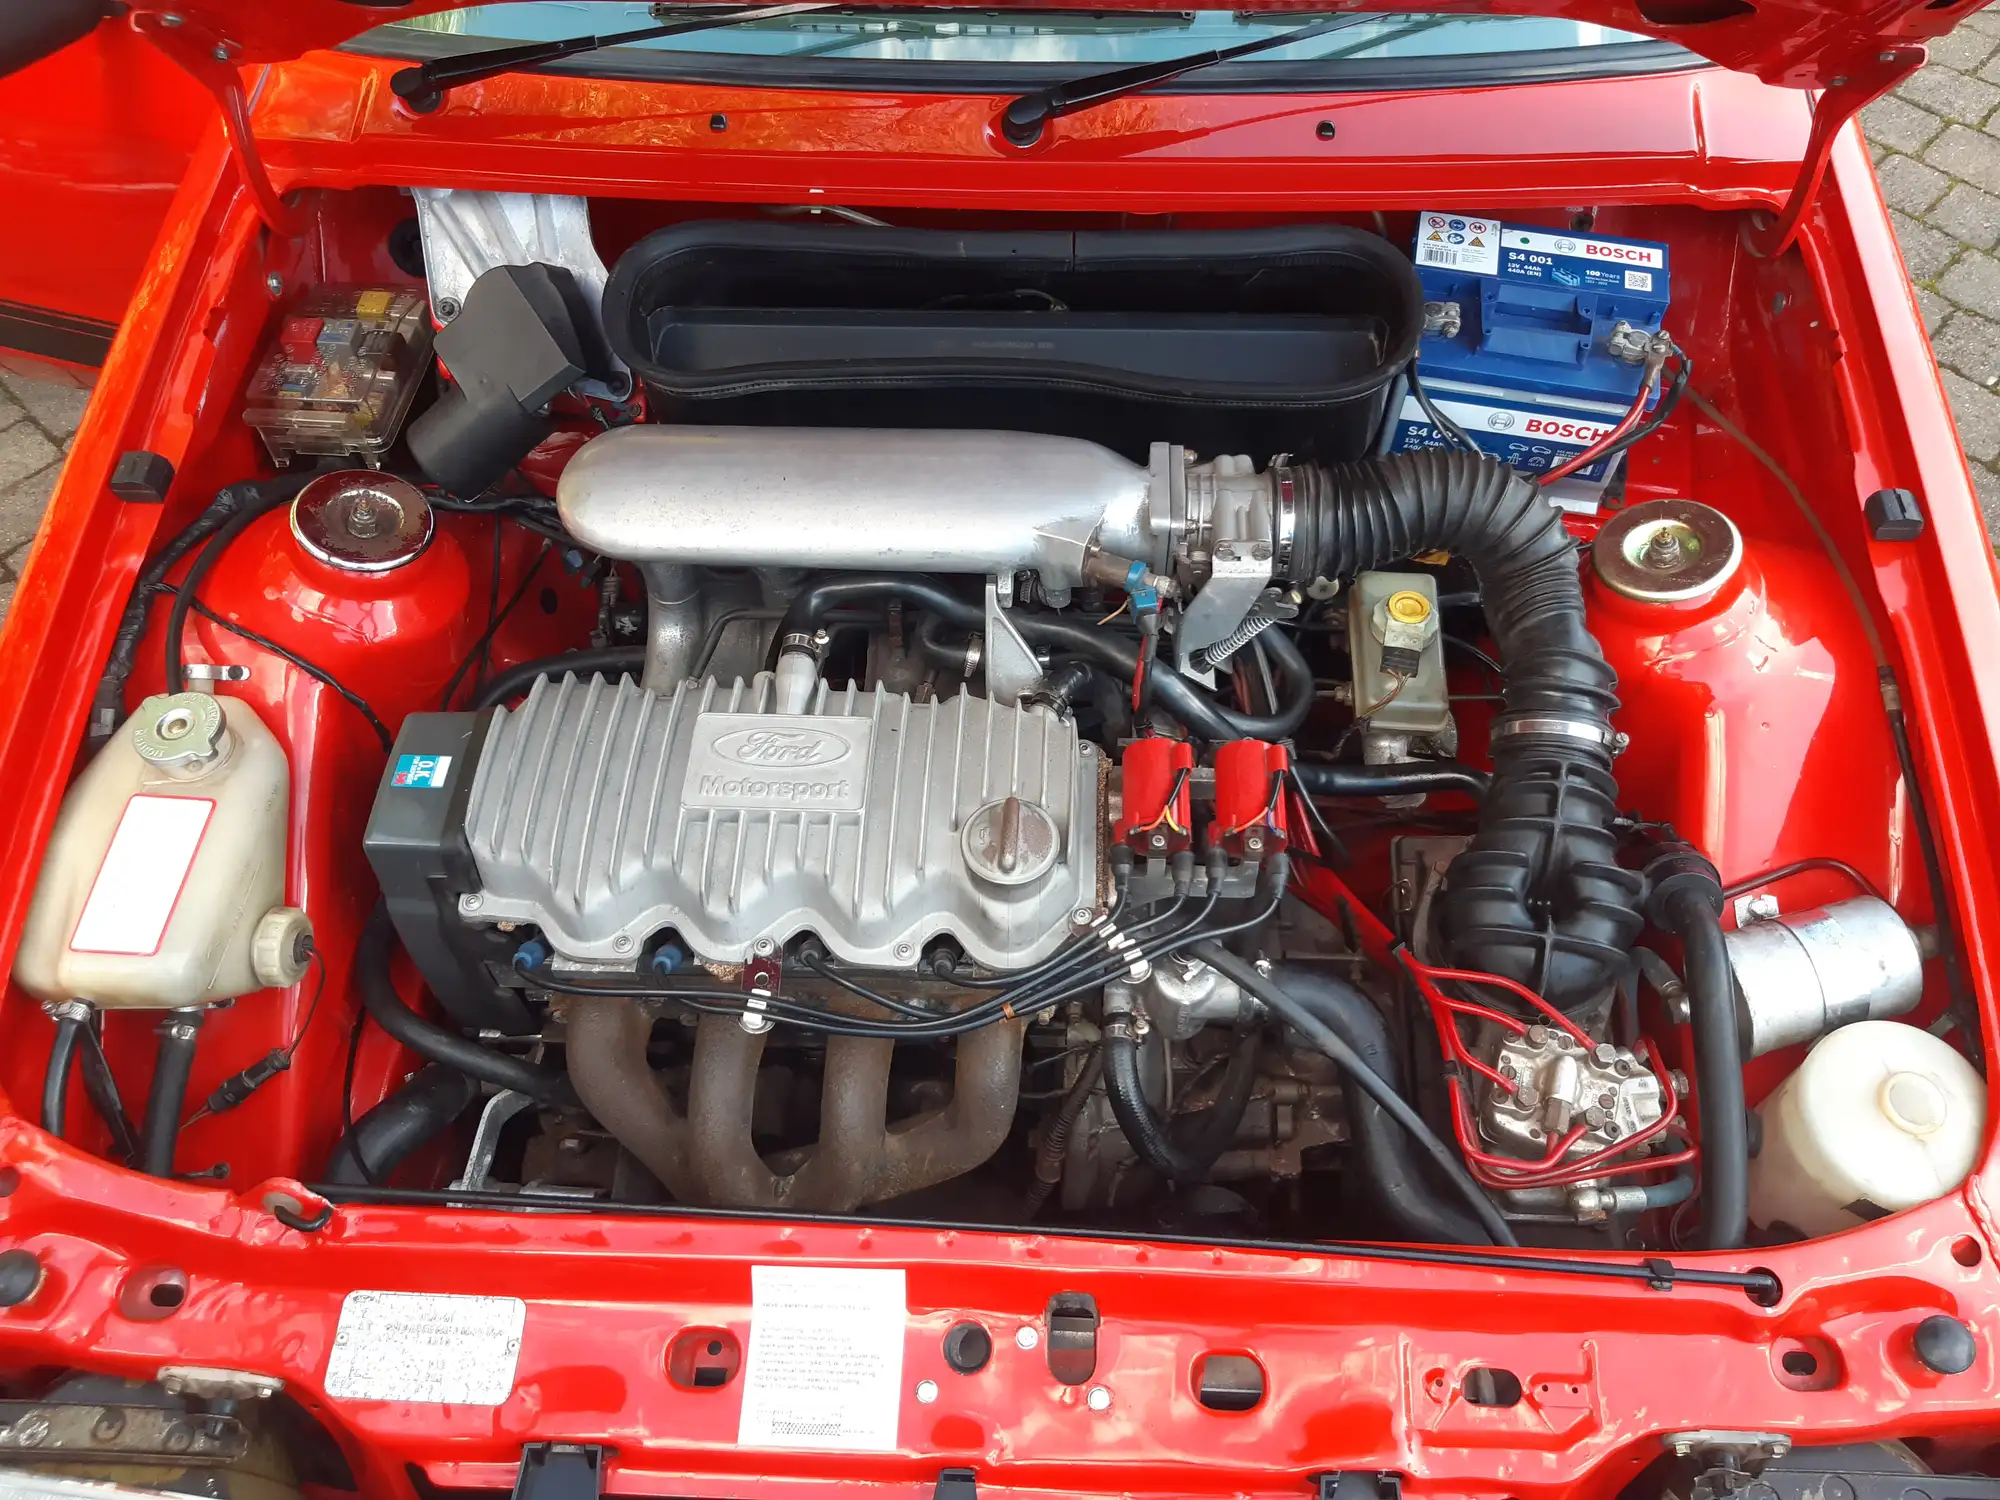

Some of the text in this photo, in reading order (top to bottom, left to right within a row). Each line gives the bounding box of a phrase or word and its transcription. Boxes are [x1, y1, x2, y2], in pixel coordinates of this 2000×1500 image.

[1508, 252, 1553, 265] S4 001
[1586, 244, 1652, 262] BOSCH
[1600, 271, 1621, 280] Years
[1407, 425, 1428, 437] S4
[1525, 419, 1610, 441] BOSCH
[737, 731, 825, 762] Ford
[699, 774, 848, 802] Motorsport
